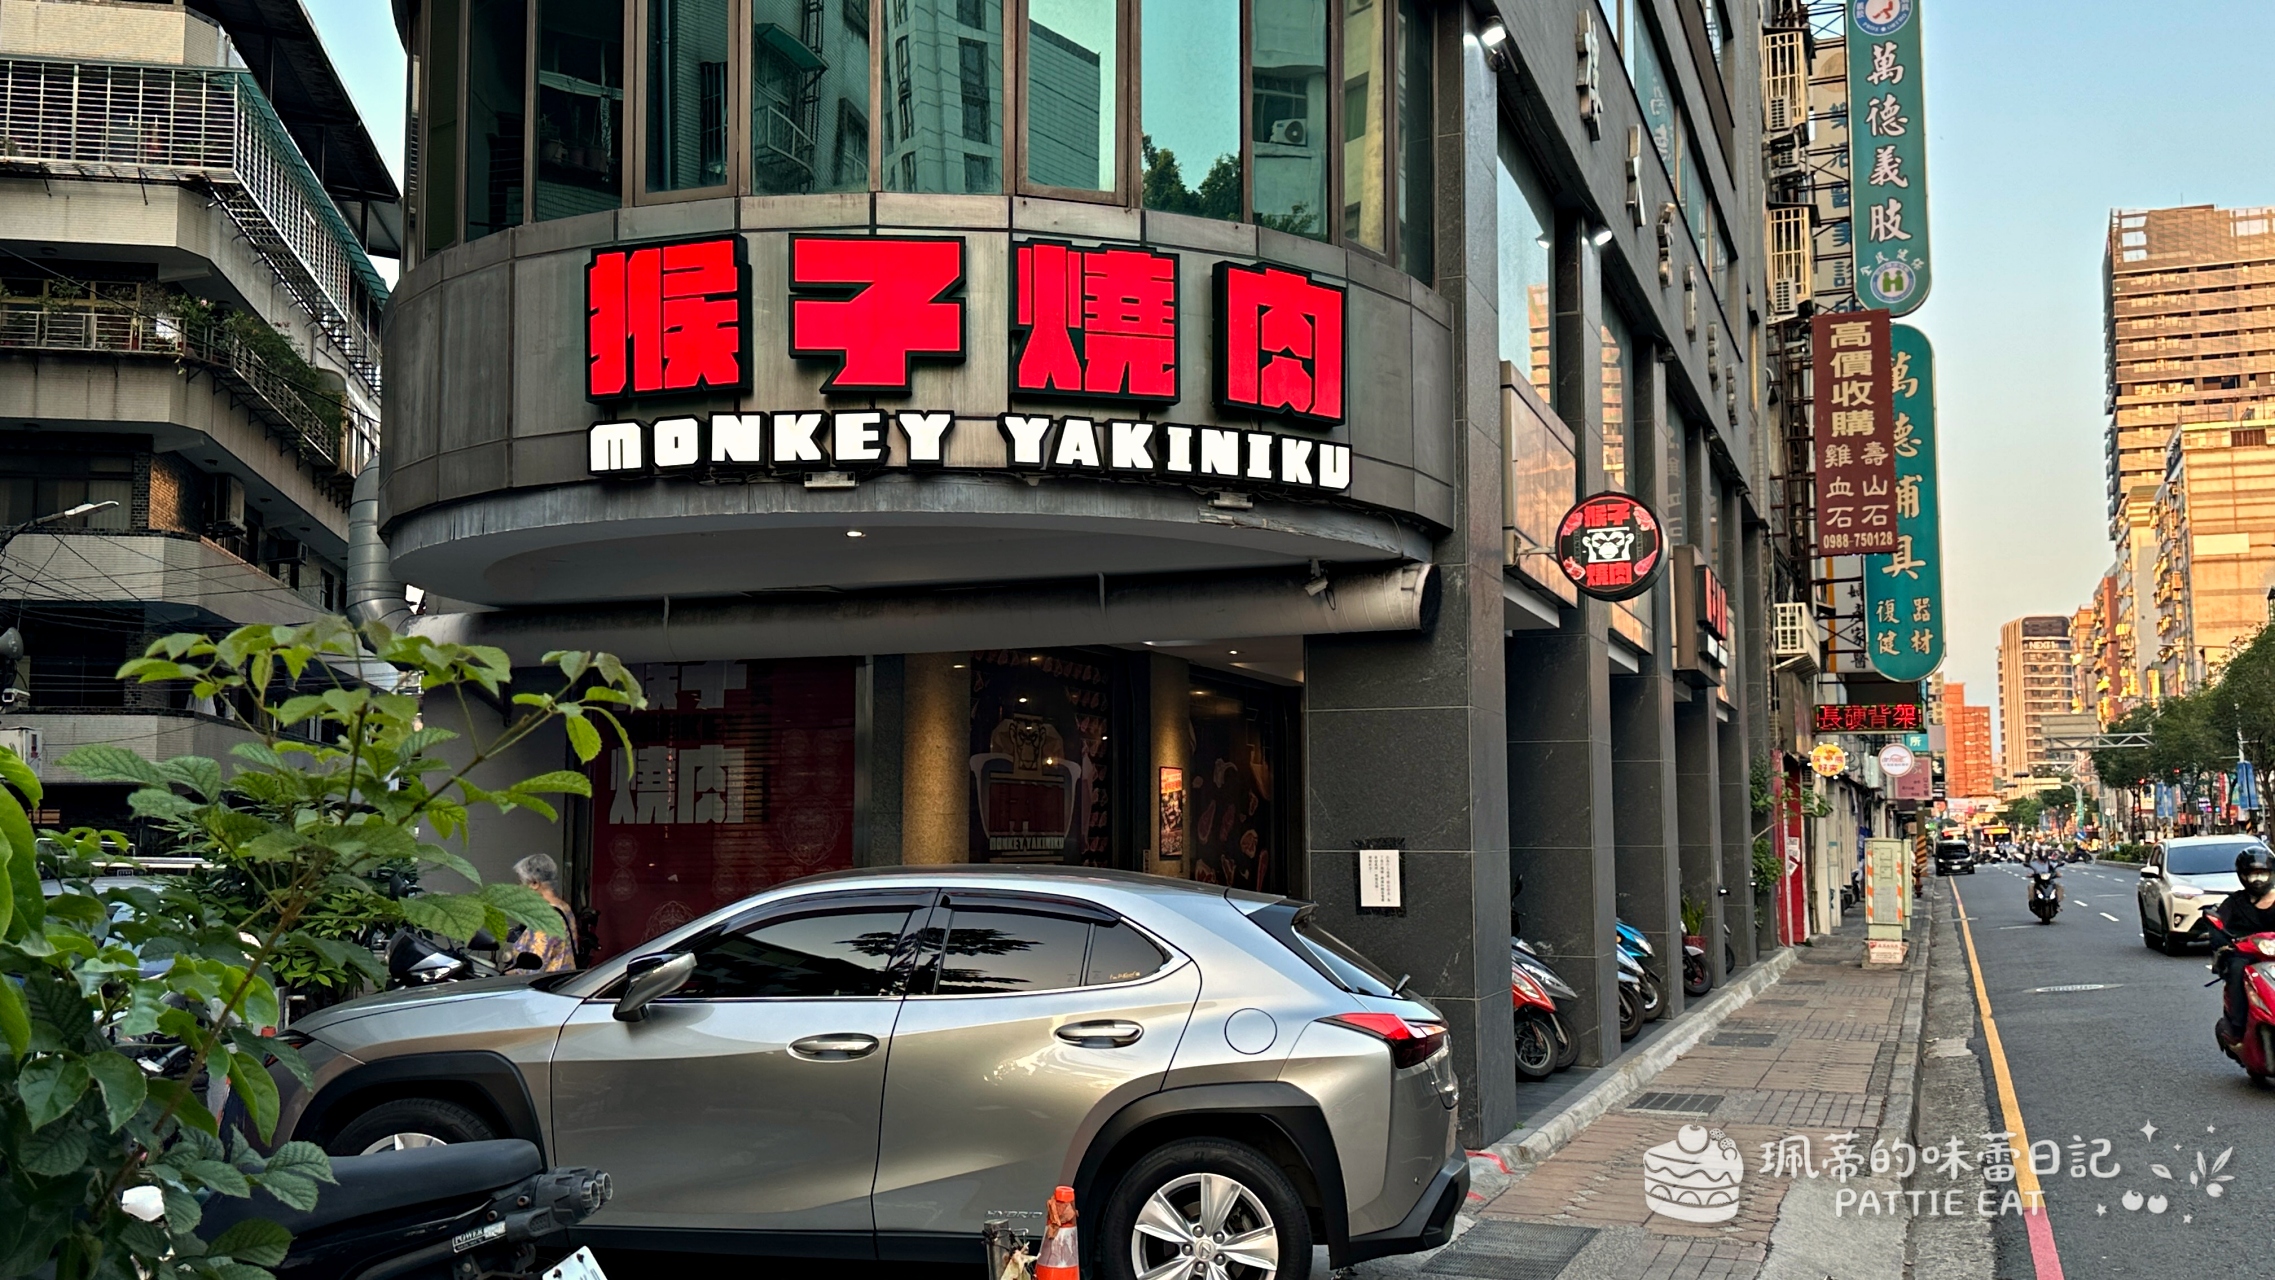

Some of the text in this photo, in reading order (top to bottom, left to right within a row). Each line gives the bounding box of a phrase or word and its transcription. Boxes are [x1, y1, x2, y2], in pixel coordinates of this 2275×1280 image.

[1864, 42, 1912, 243] 萬德義肢
[590, 239, 1343, 419] 猴子燒肉
[1829, 320, 1876, 438] 高價收購
[589, 412, 1351, 490] MONKEY YAKINIKU
[1825, 443, 1854, 528] 雞血石
[1861, 441, 1889, 527] 壽山石
[1584, 503, 1631, 527] 猴子
[1823, 531, 1893, 549] 0988-750128
[1586, 562, 1632, 586] 燒肉
[1876, 598, 1901, 656] 復健
[1910, 598, 1934, 655] 器材
[609, 745, 745, 825] 燒肉
